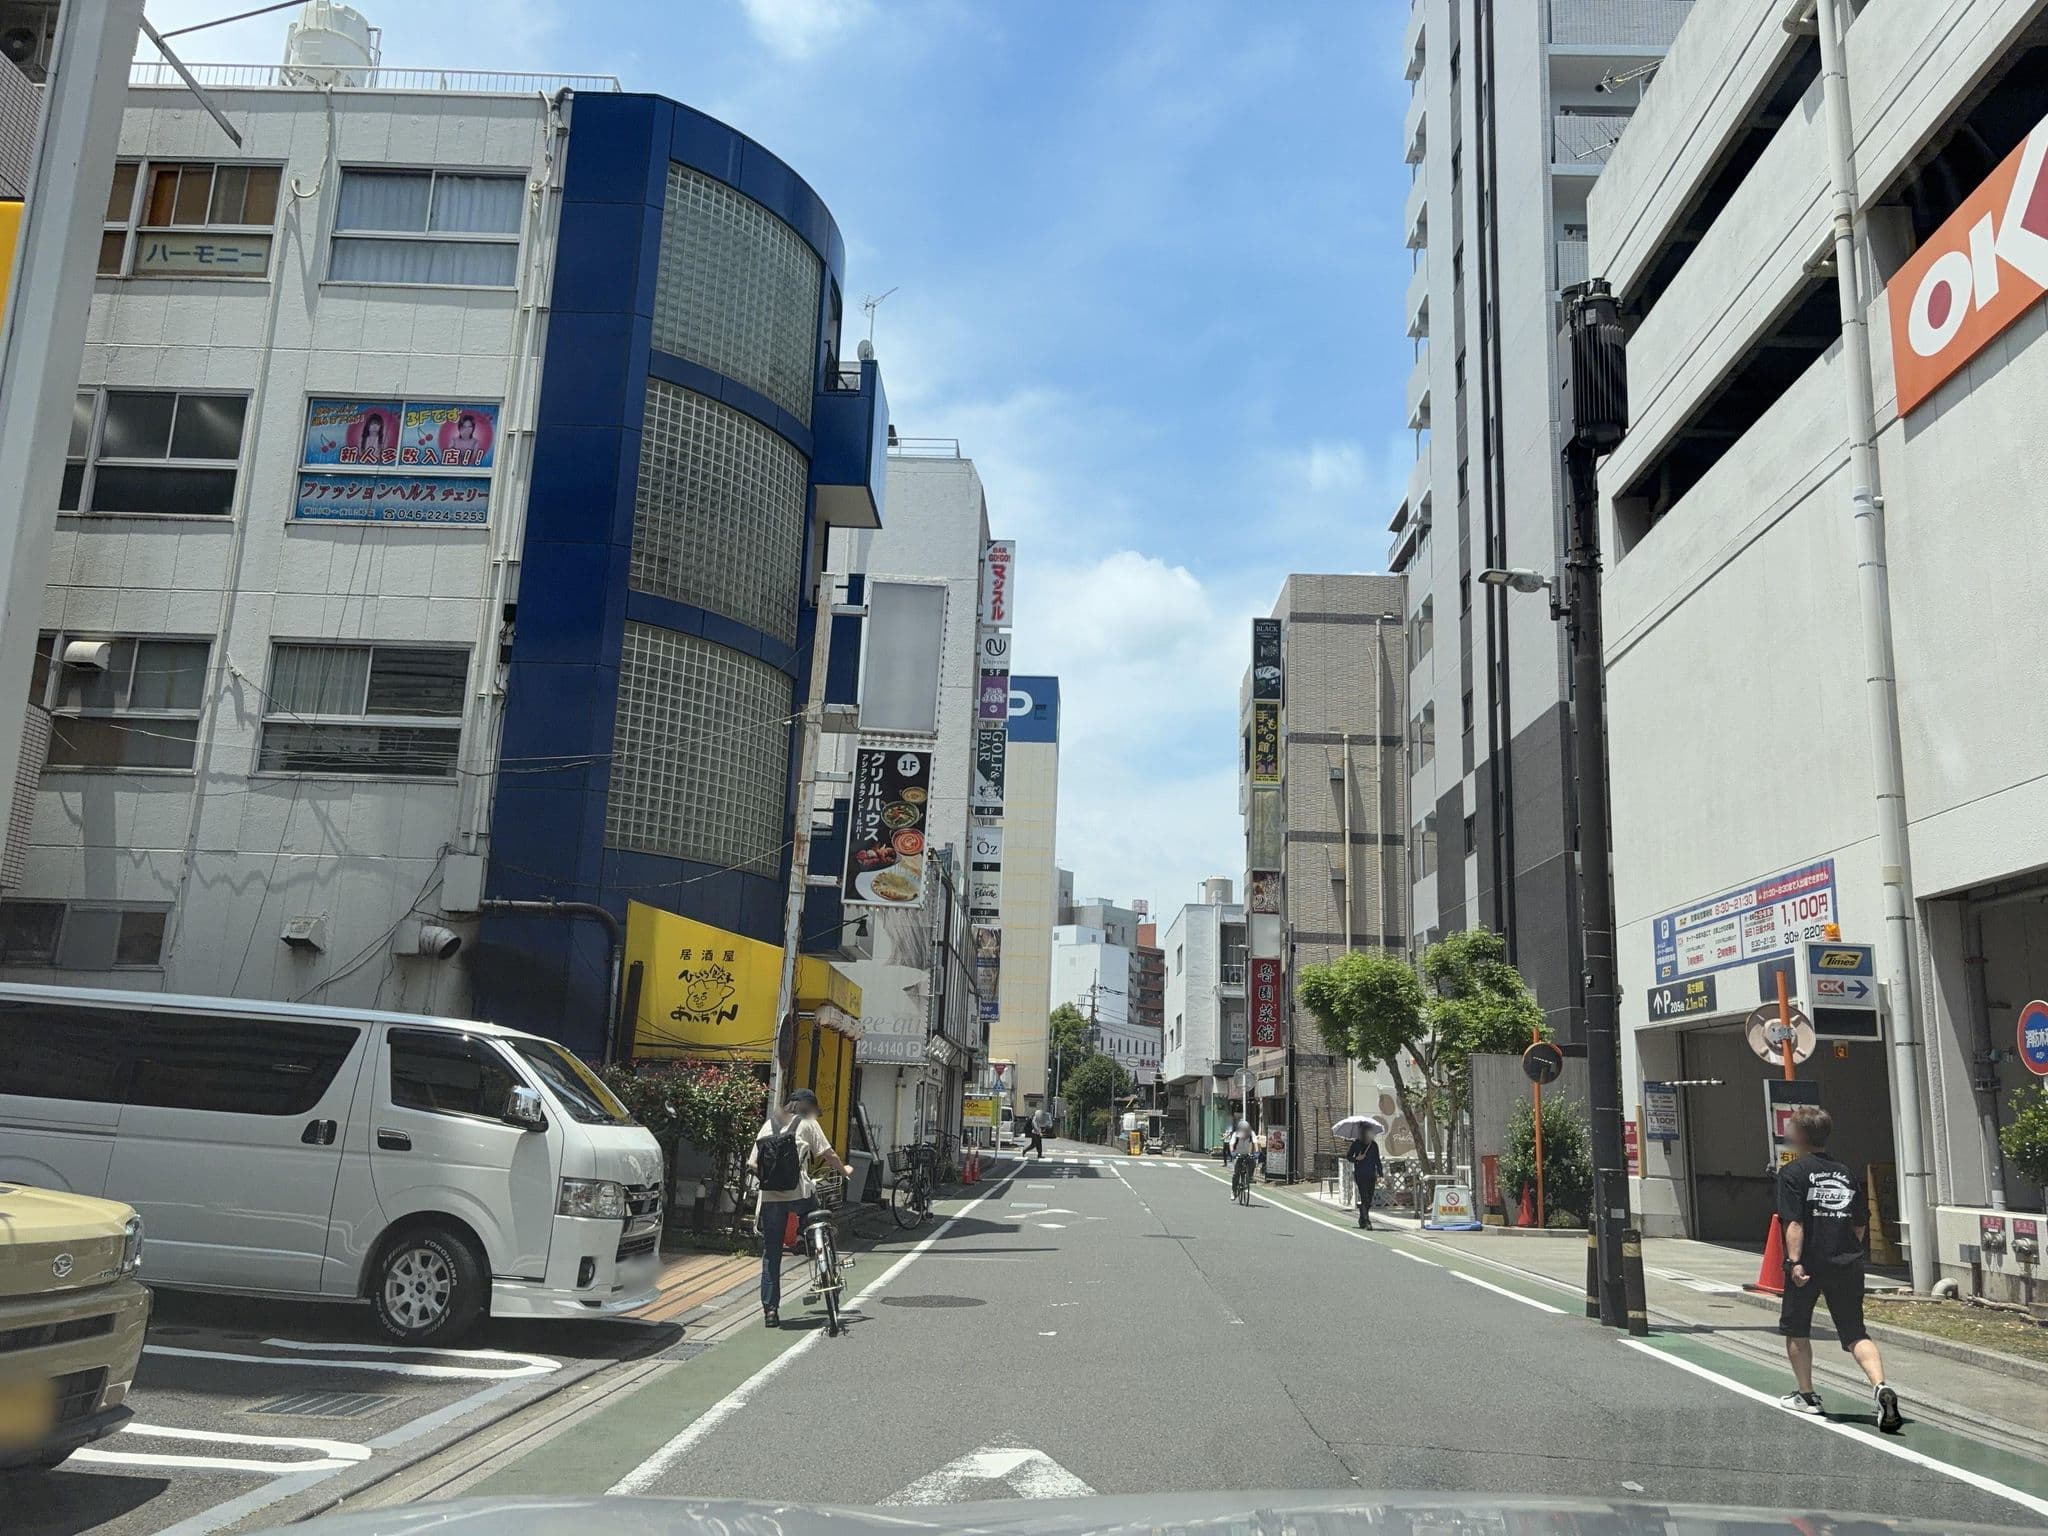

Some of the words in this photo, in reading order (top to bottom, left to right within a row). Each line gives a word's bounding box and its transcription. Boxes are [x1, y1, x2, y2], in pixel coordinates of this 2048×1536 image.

[1908, 112, 2048, 357] OK
[146, 244, 263, 264] ハーモニー
[301, 482, 438, 501] ファッションヘルス
[398, 509, 486, 522] 046-224-5253
[979, 732, 992, 761] BAR
[901, 760, 917, 771] 1F
[864, 752, 886, 842] グリルハウス
[977, 841, 998, 855] Oz
[1781, 893, 1829, 926] 1,100円
[680, 949, 735, 962] 居酒屋
[1825, 953, 1859, 967] Times
[1820, 981, 1844, 994] OK
[1663, 990, 1671, 1014] P
[424, 1239, 458, 1287] YOKOHAMA
